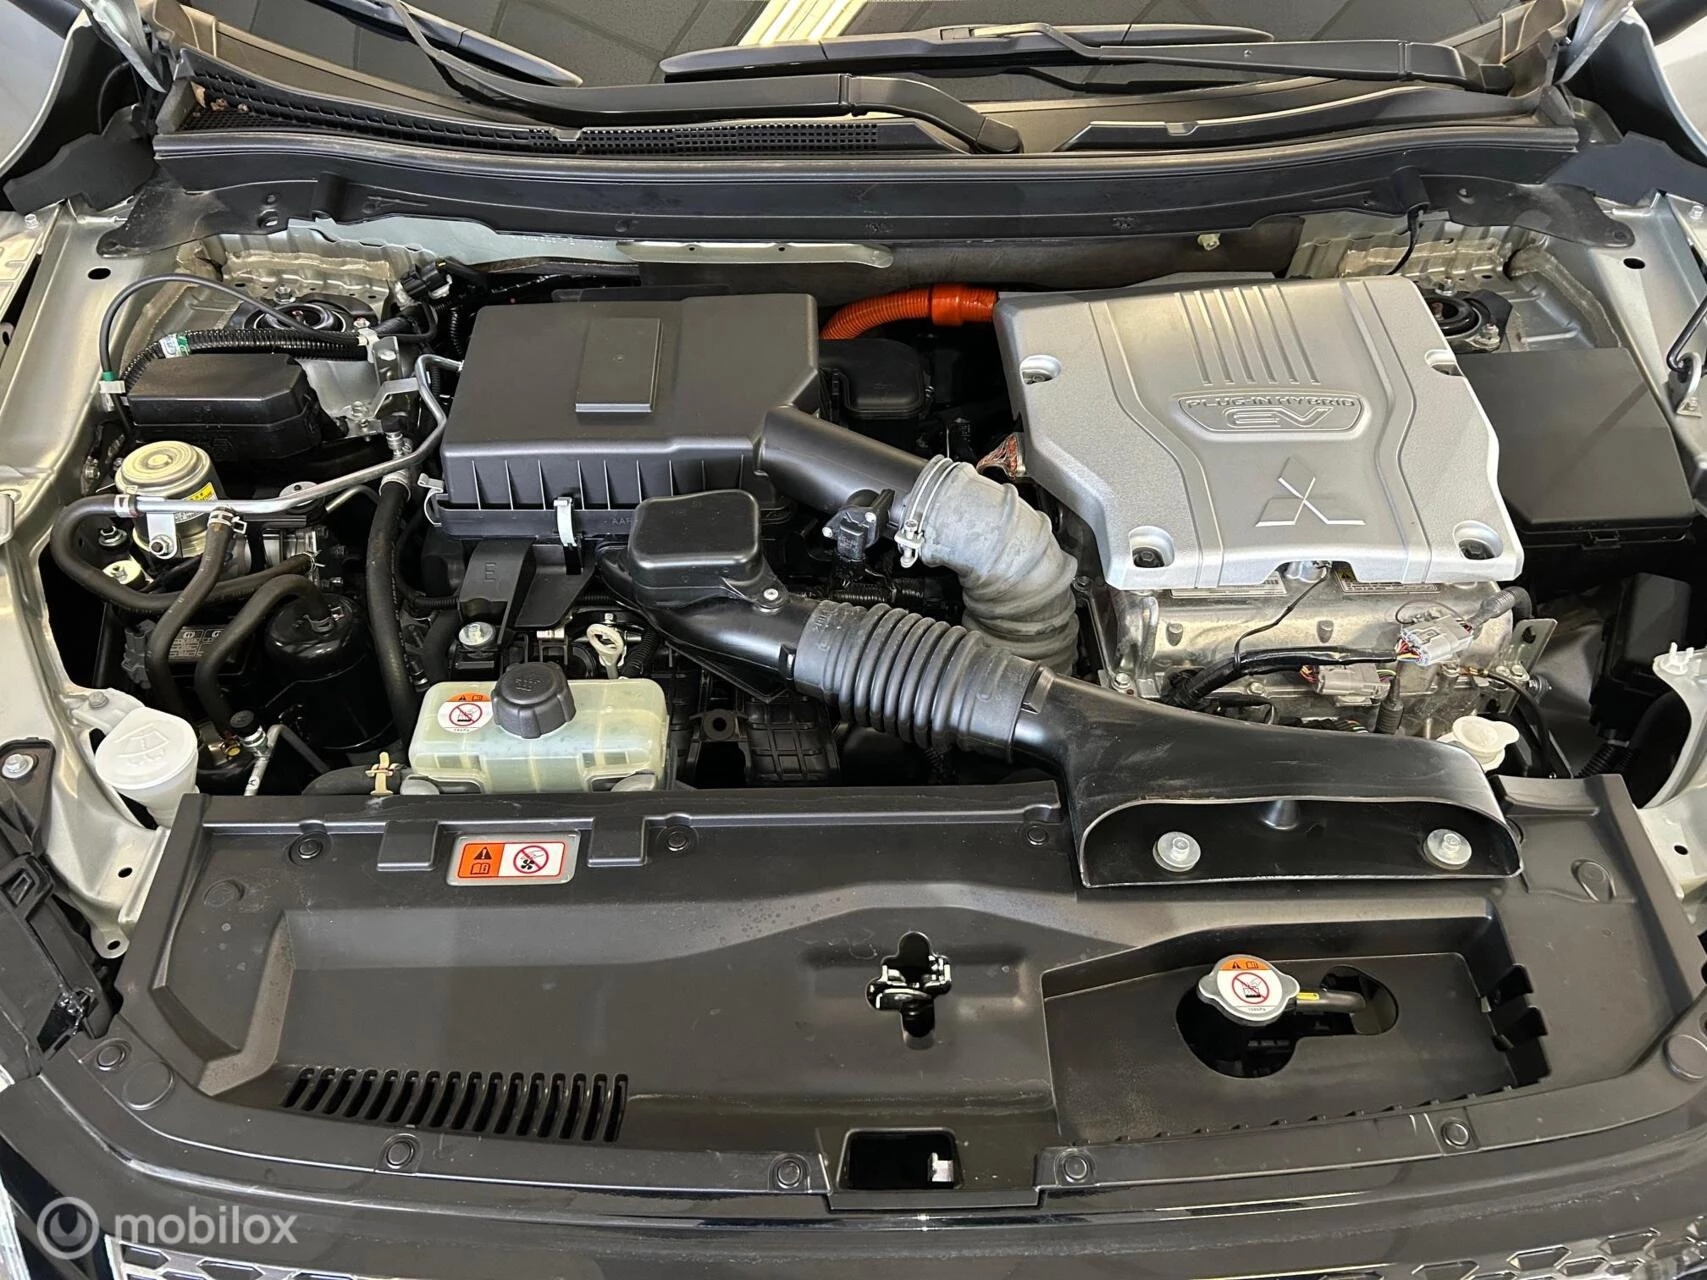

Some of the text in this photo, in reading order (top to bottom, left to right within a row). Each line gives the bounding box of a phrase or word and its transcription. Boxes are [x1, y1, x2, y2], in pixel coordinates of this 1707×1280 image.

[1186, 395, 1356, 408] PLUG-IN HYBRID
[1223, 406, 1333, 428] EV
